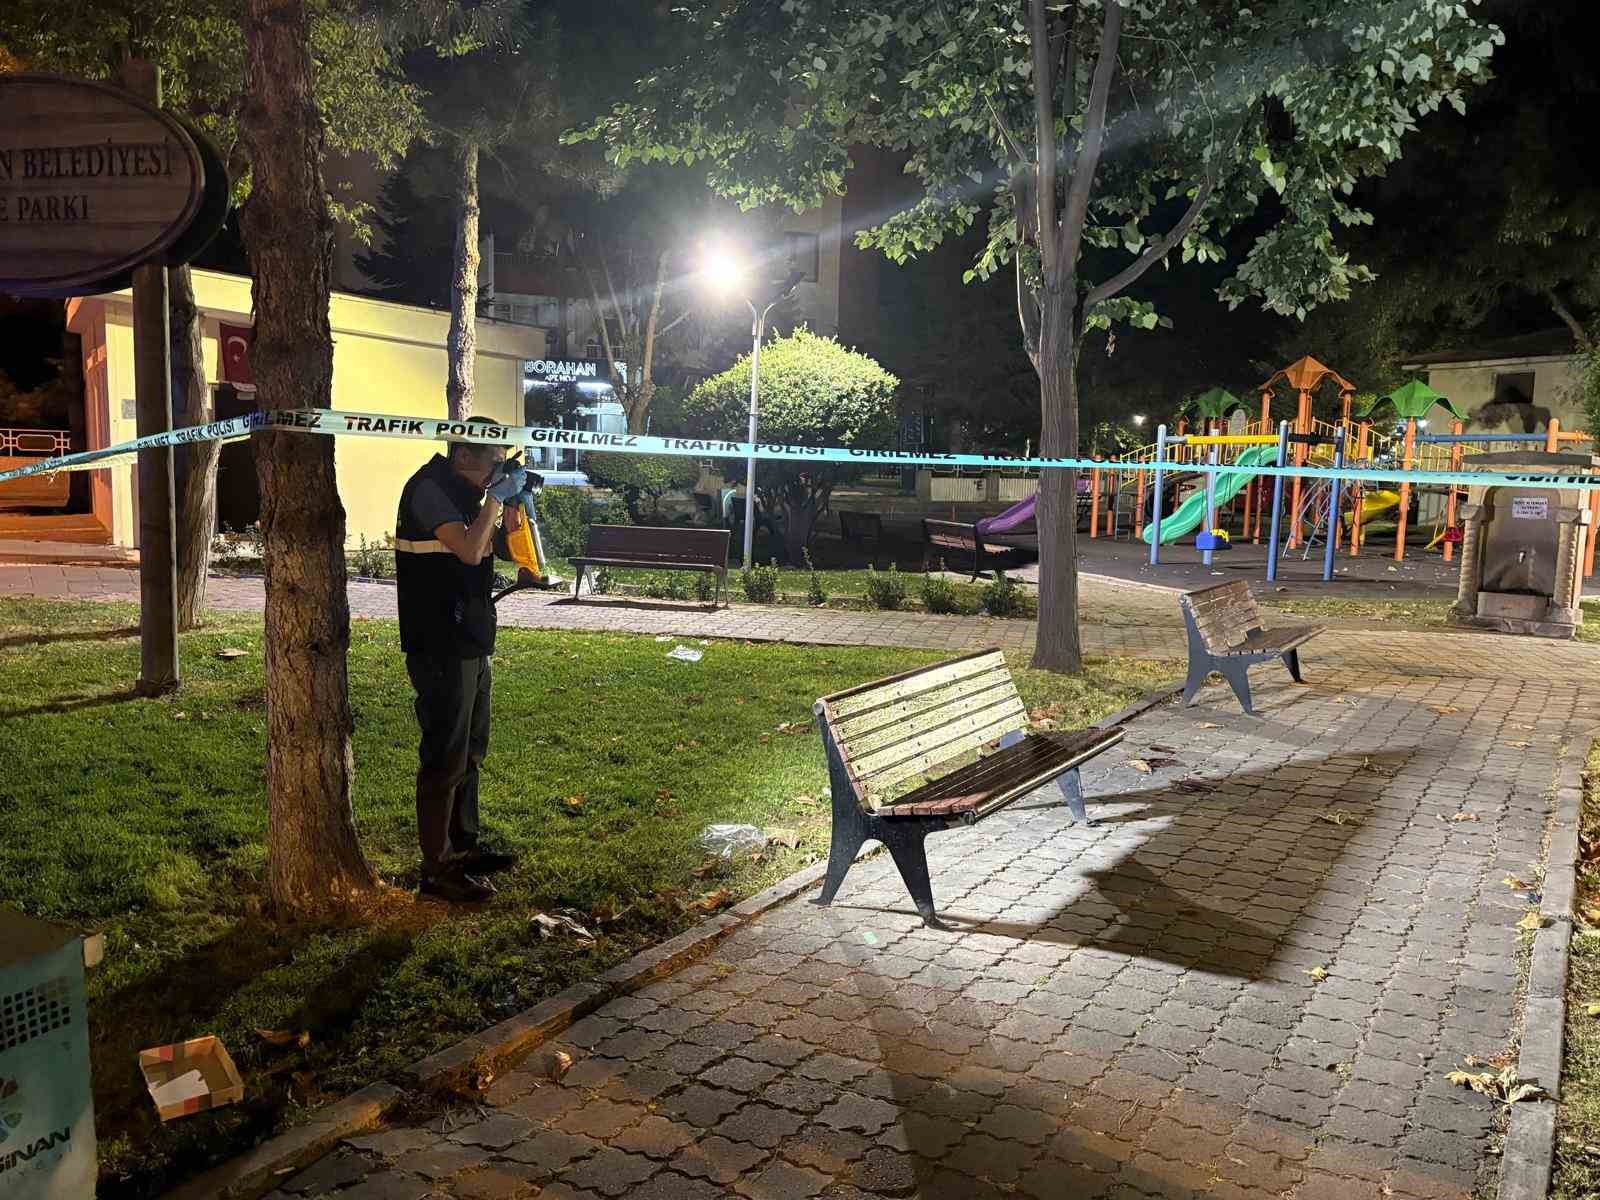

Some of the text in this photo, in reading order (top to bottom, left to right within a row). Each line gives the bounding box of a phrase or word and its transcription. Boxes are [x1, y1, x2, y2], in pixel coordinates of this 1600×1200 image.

[22, 137, 174, 178] BELEDİYESİ
[17, 195, 89, 222] PARKI
[524, 360, 596, 376] BORAHAN
